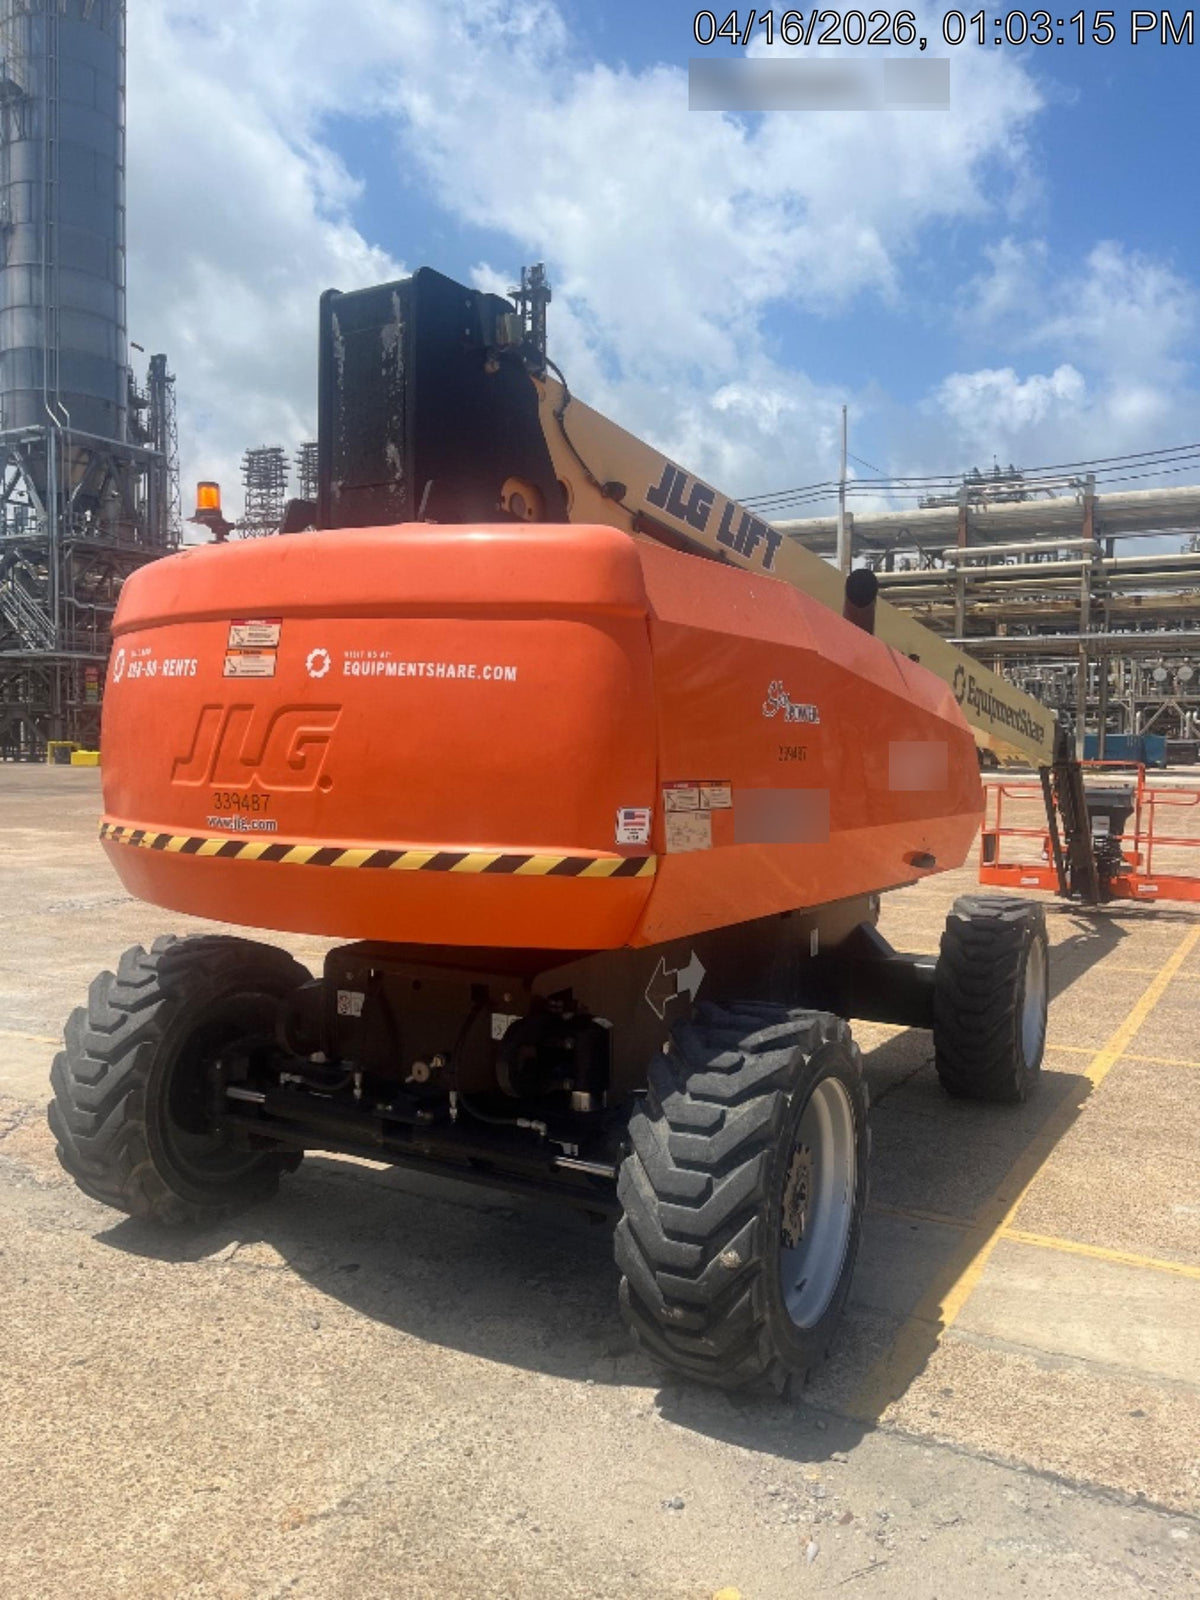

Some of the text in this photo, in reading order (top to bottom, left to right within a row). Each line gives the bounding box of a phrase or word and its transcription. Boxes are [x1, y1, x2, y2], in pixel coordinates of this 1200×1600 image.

[645, 462, 784, 572] JLG LIFT
[343, 660, 518, 681] EQUIPMENTSHARE.COM
[214, 792, 271, 811] 339487
[206, 814, 278, 832] www.jlg.com
